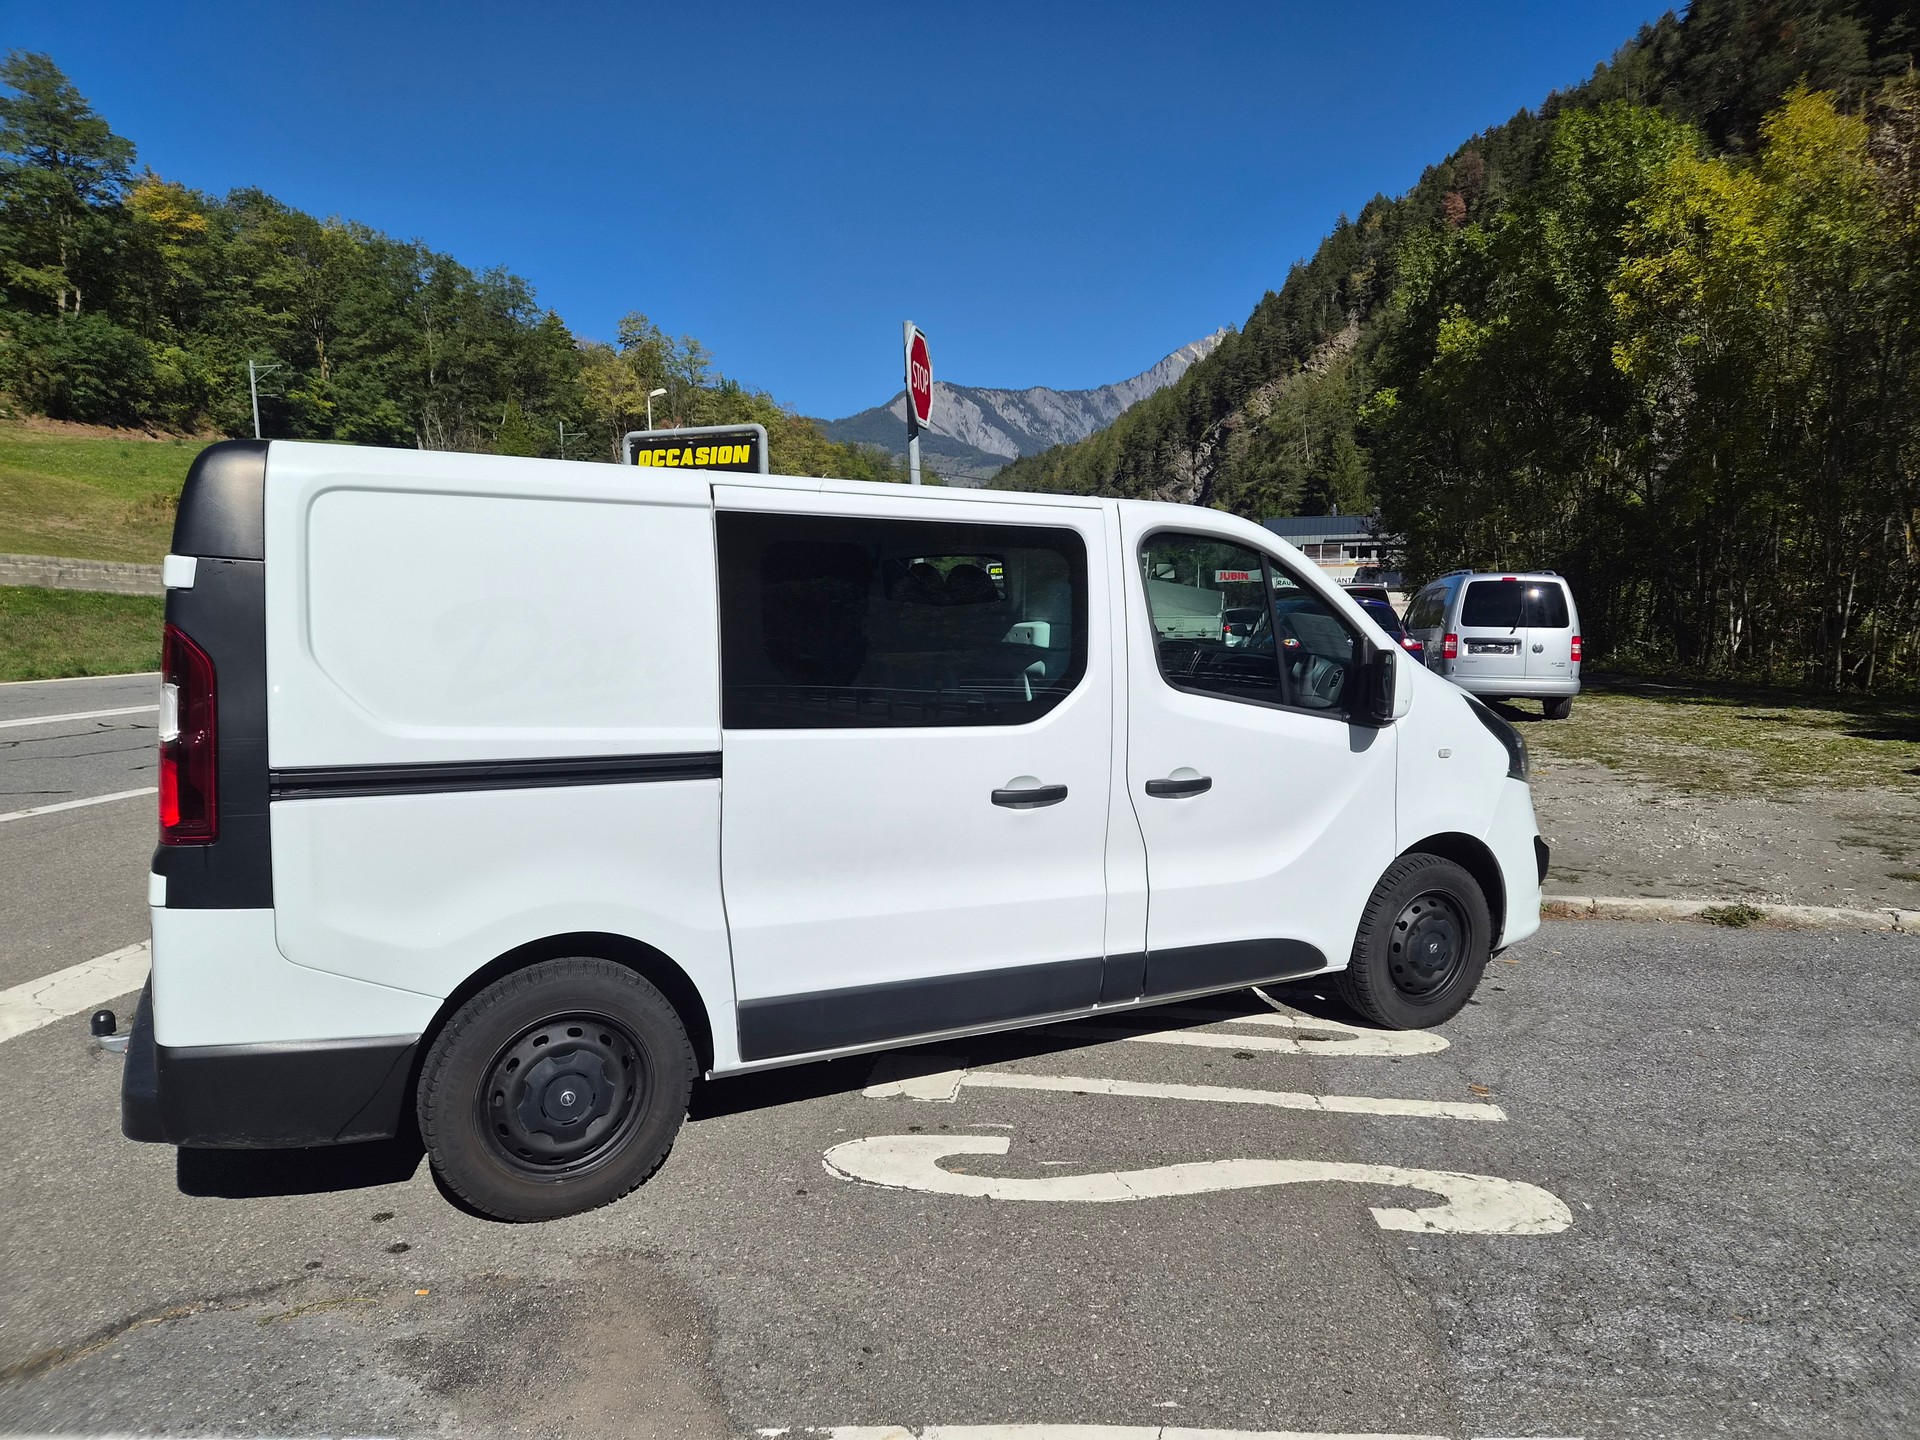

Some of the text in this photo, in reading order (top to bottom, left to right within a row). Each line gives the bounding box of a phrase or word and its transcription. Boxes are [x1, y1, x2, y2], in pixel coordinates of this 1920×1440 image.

[913, 360, 928, 395] STOP
[638, 444, 750, 467] OCCASION
[1219, 571, 1249, 581] JUBIN
